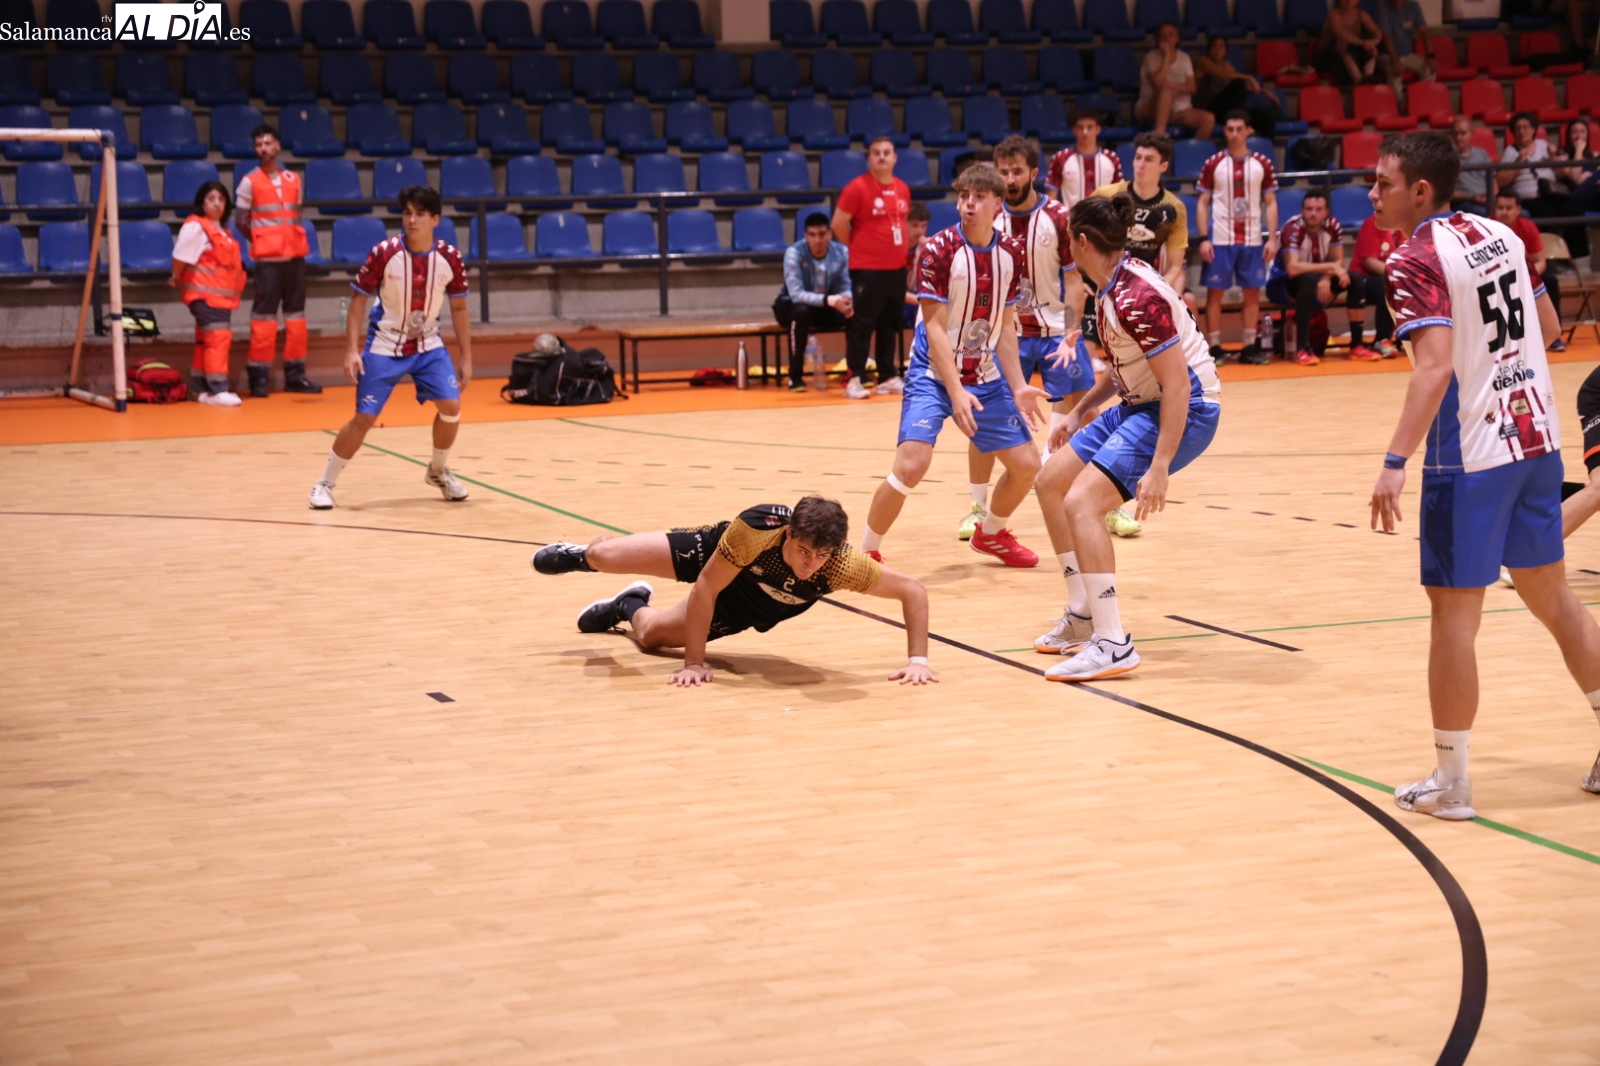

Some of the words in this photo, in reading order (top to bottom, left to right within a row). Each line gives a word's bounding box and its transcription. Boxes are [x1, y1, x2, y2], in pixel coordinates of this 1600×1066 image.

[1134, 208, 1150, 222] 27
[978, 294, 990, 307] 18
[1476, 269, 1525, 354] 56
[783, 577, 796, 592] 2
